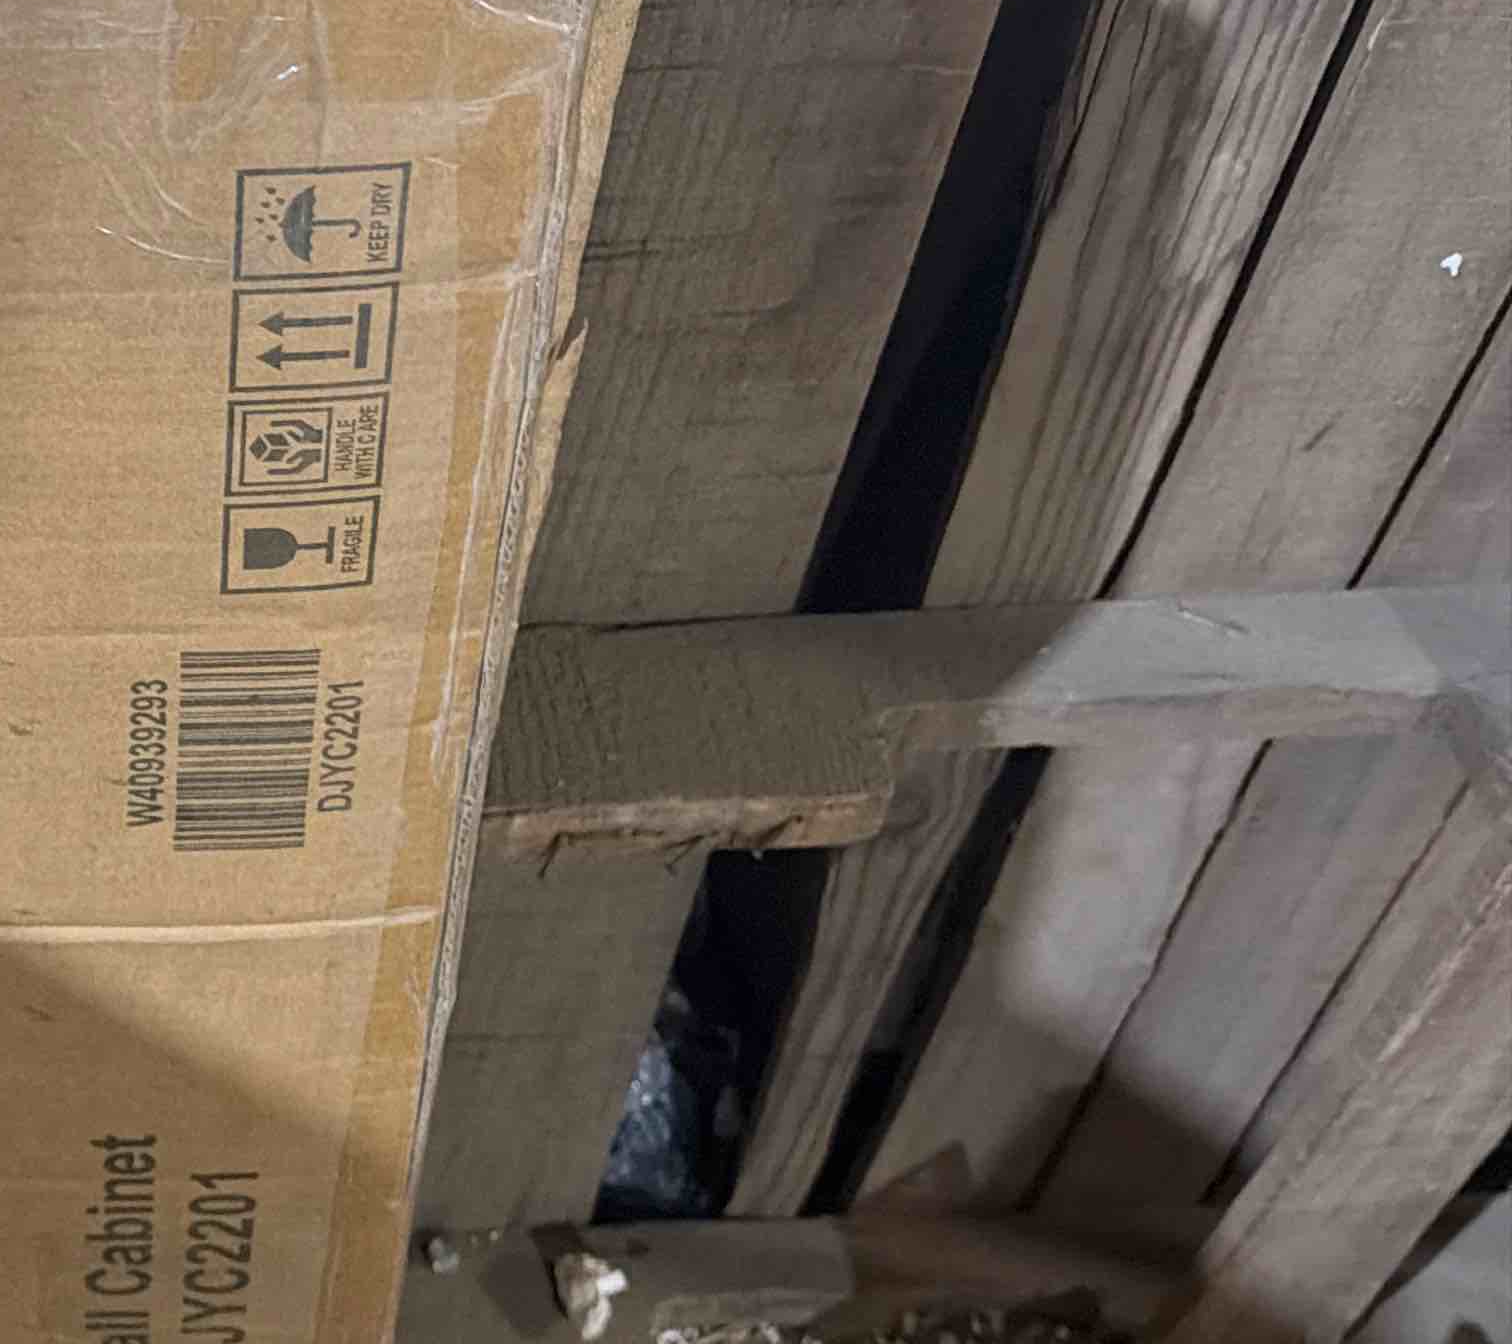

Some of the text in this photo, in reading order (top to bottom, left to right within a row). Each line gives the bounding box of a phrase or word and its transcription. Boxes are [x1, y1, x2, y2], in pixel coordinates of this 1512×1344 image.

[366, 181, 394, 263] KEEP DRY
[334, 418, 358, 472] HANDLE
[354, 446, 377, 481] WITH
[340, 514, 365, 574] FRAGILE
[126, 679, 168, 827] W40939293
[316, 680, 365, 813] DJYC2201
[84, 1134, 157, 1297] Cabinet
